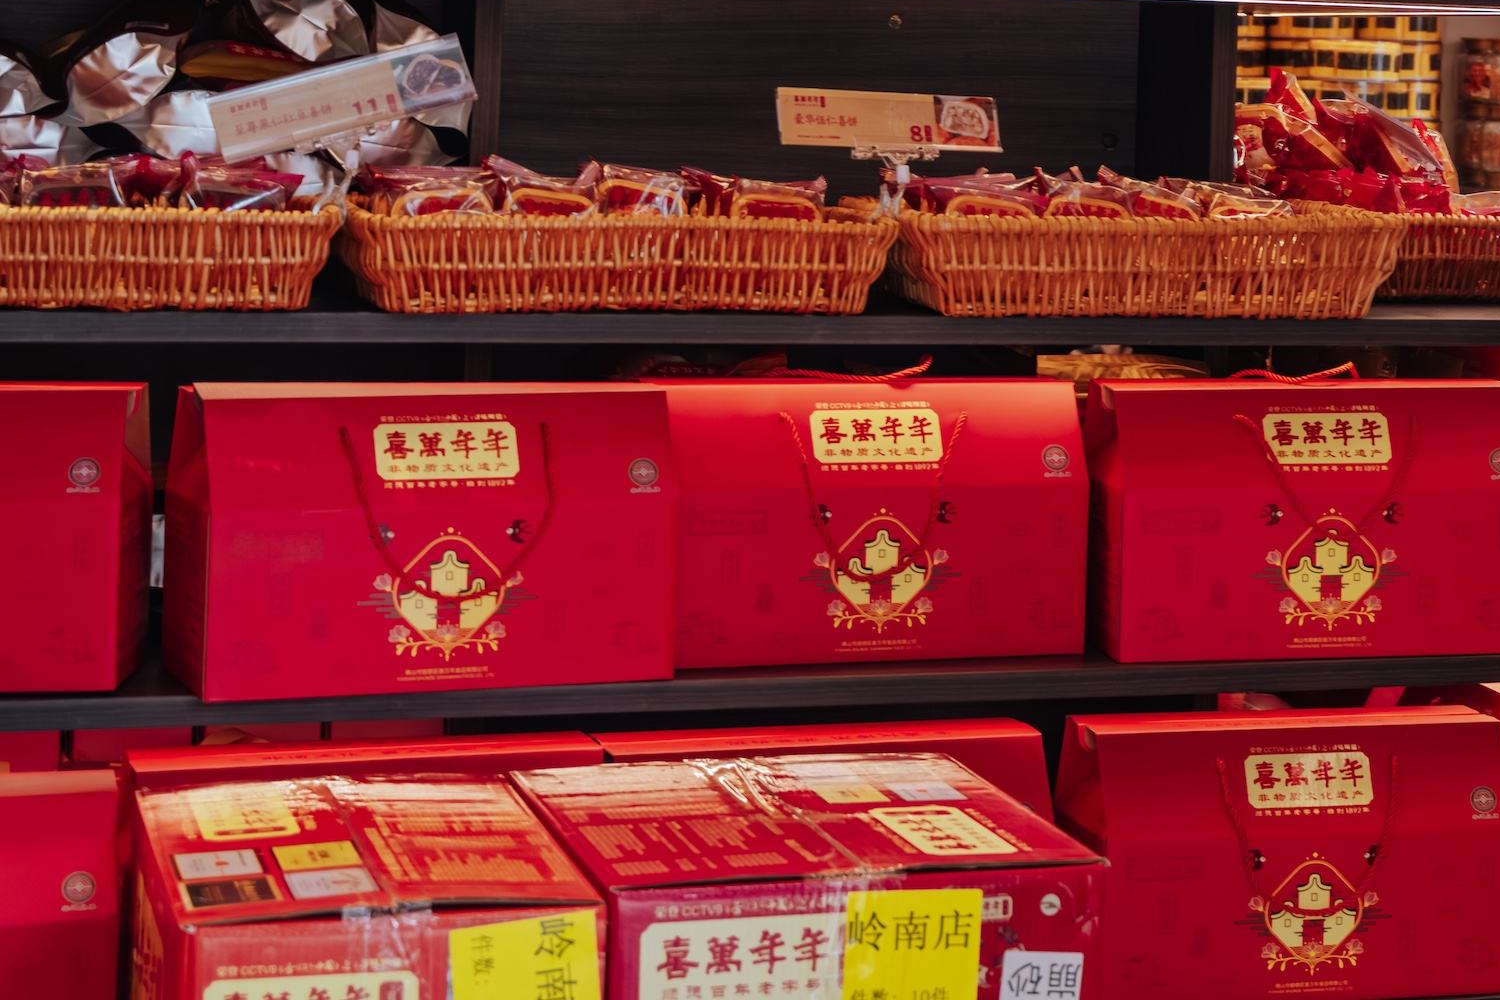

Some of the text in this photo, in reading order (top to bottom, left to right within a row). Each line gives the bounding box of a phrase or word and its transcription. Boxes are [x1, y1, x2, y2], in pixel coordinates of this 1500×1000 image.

[351, 96, 379, 115] 11
[910, 124, 923, 142] 8
[384, 427, 510, 460] 喜萬年年
[820, 415, 933, 445] 喜萬年年
[1271, 418, 1383, 446] 喜萬年年
[824, 446, 933, 457] 非物质文化遗产
[387, 462, 509, 473] 非物质文化遗产
[1253, 758, 1364, 789] 喜萬年年
[848, 910, 974, 951] 岭南店
[656, 927, 829, 980] 喜萬年年
[1008, 962, 1082, 998] 崩砂
